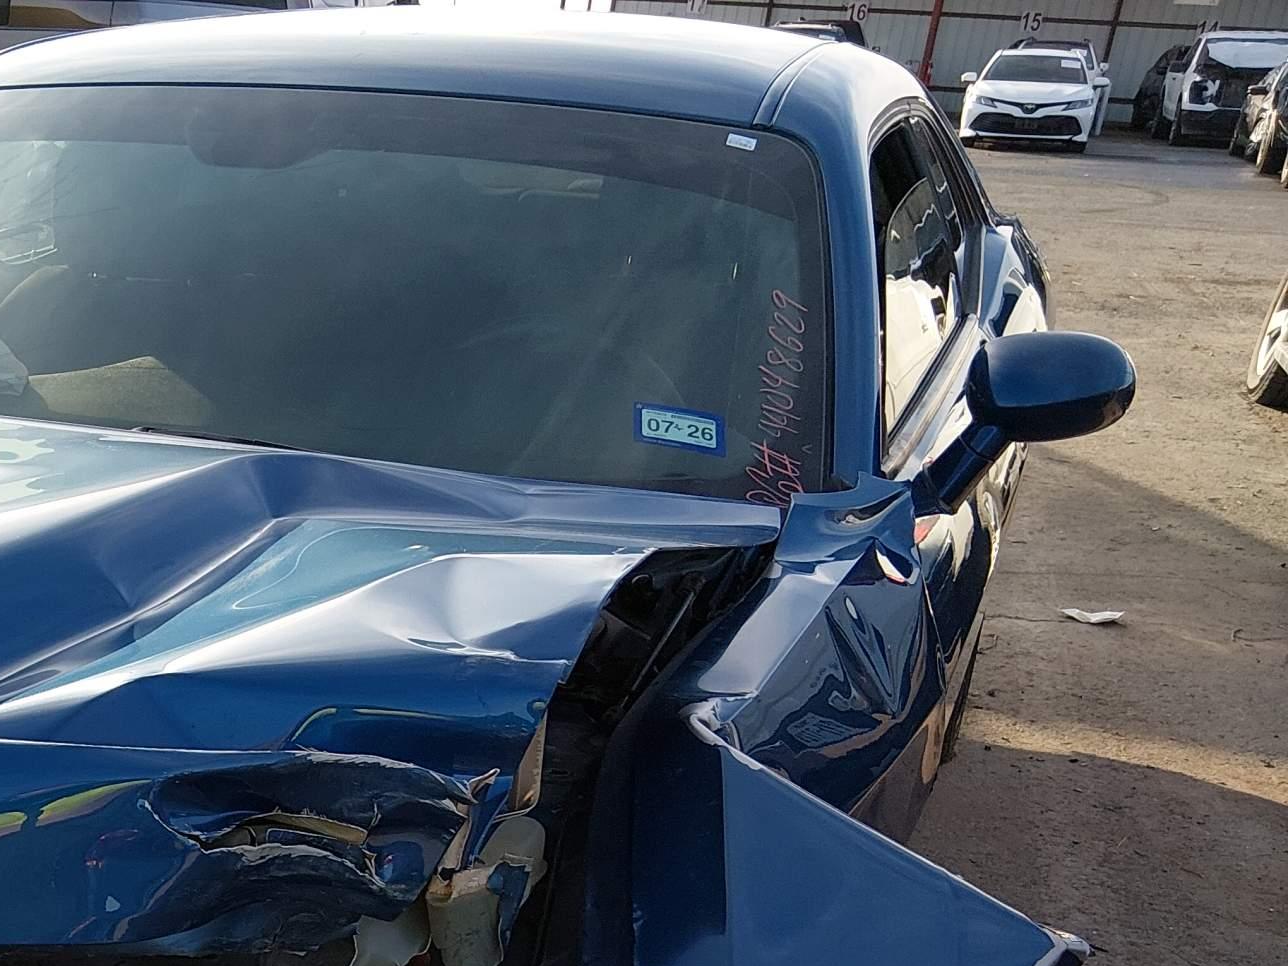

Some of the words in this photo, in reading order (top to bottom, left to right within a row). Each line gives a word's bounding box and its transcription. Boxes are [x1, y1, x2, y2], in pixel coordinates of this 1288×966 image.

[848, 4, 867, 21] 16
[1021, 12, 1043, 32] 15
[647, 418, 675, 434] 07
[687, 424, 714, 442] 26
